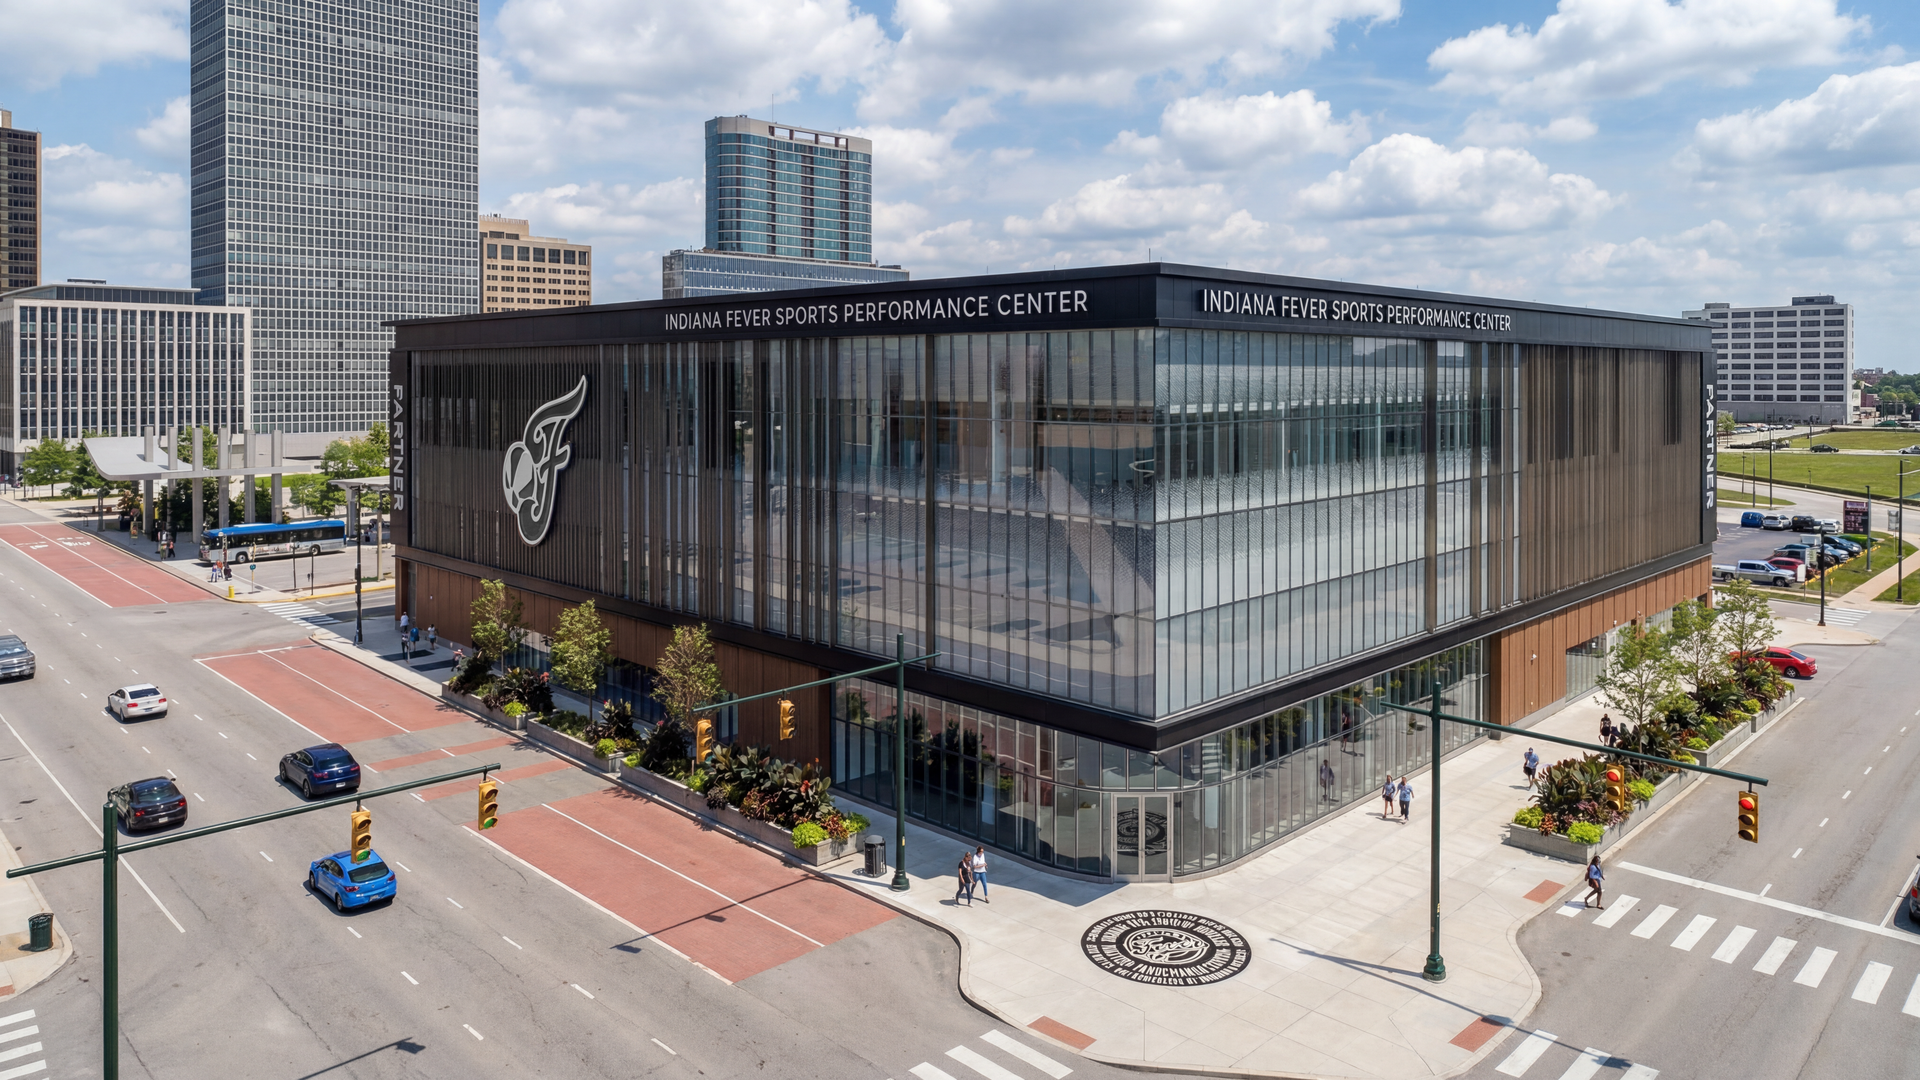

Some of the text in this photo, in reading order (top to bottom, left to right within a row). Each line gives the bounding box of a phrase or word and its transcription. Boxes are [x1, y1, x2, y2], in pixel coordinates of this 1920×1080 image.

[665, 290, 1088, 331] INDIANA FEVER SPORTS PERFORMANCE CENTER
[1203, 288, 1511, 332] INDIANA FEVER SPORTS PERFORMANCE CENTER
